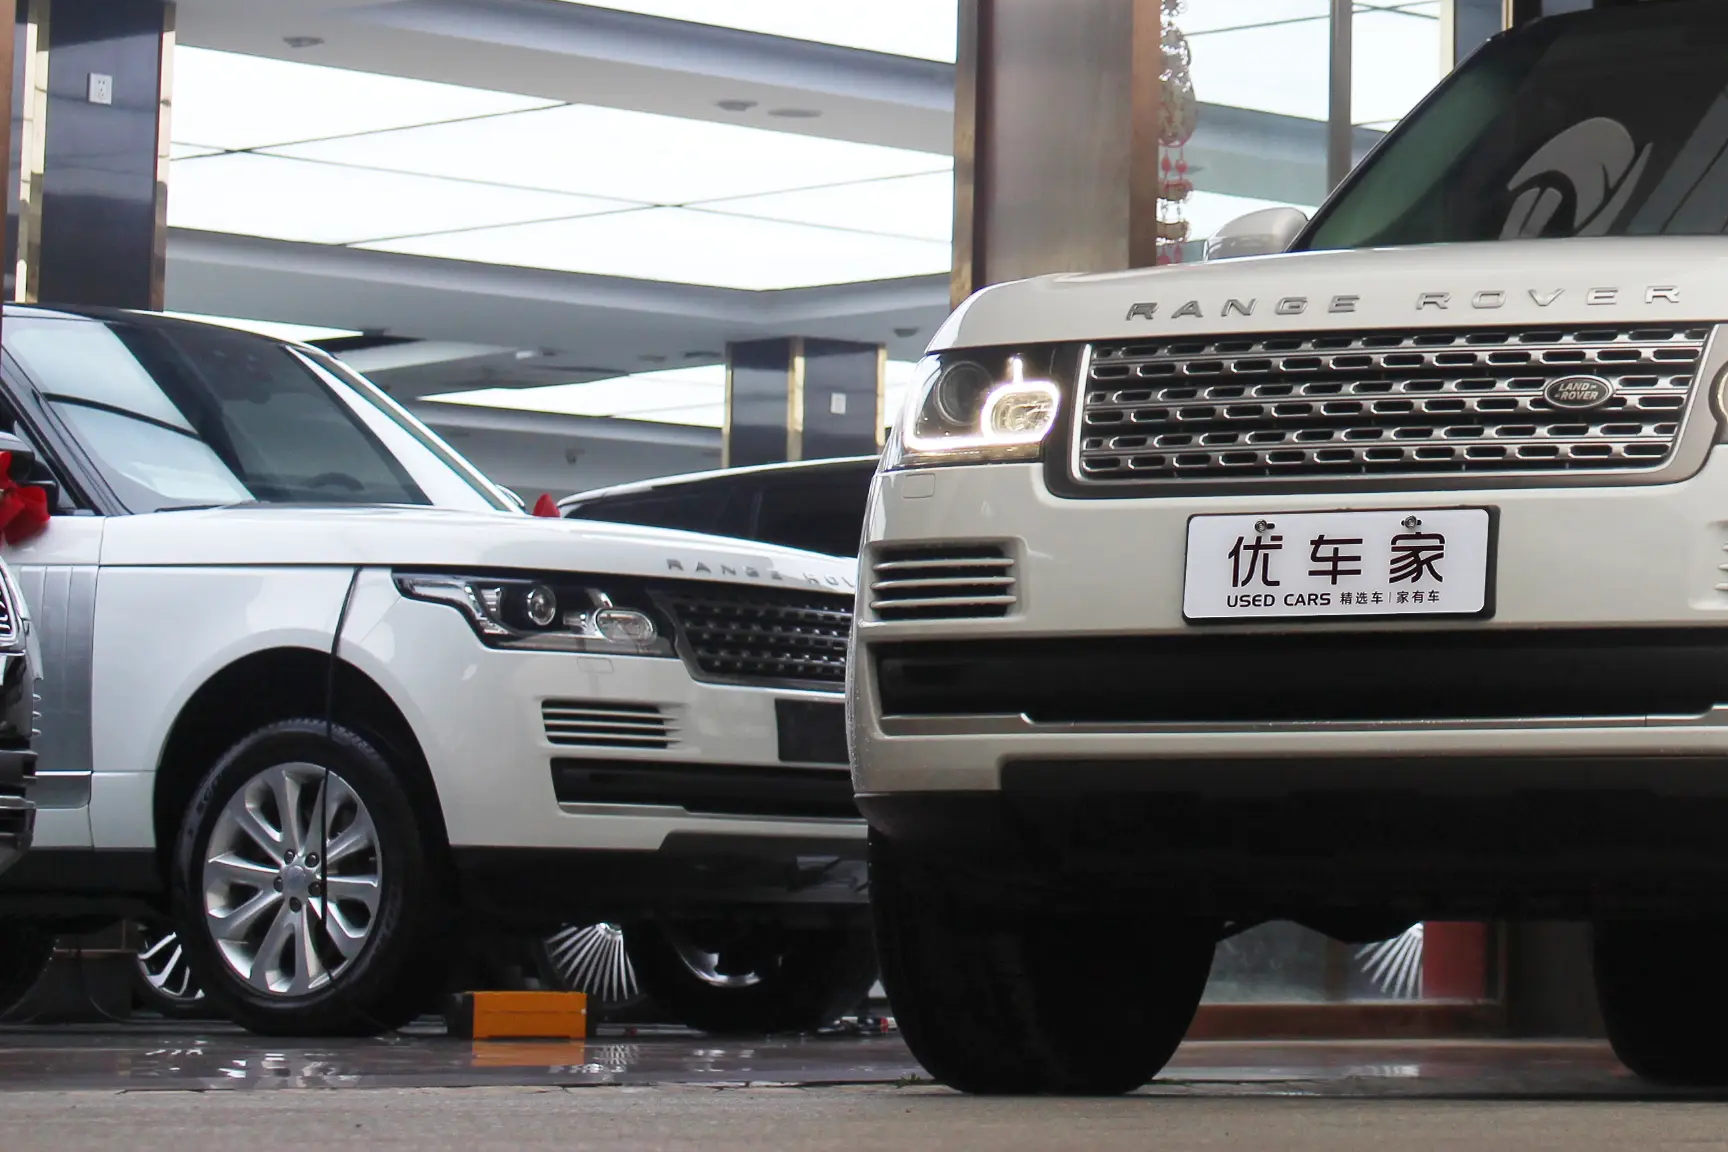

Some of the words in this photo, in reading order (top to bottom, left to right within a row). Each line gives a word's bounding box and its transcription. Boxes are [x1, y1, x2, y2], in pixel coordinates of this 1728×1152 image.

[1125, 294, 1361, 321] RANGE
[1415, 284, 1681, 311] ROVER
[1226, 531, 1447, 589] 优车家
[1226, 594, 1276, 608] USED
[1283, 592, 1332, 607] CARS
